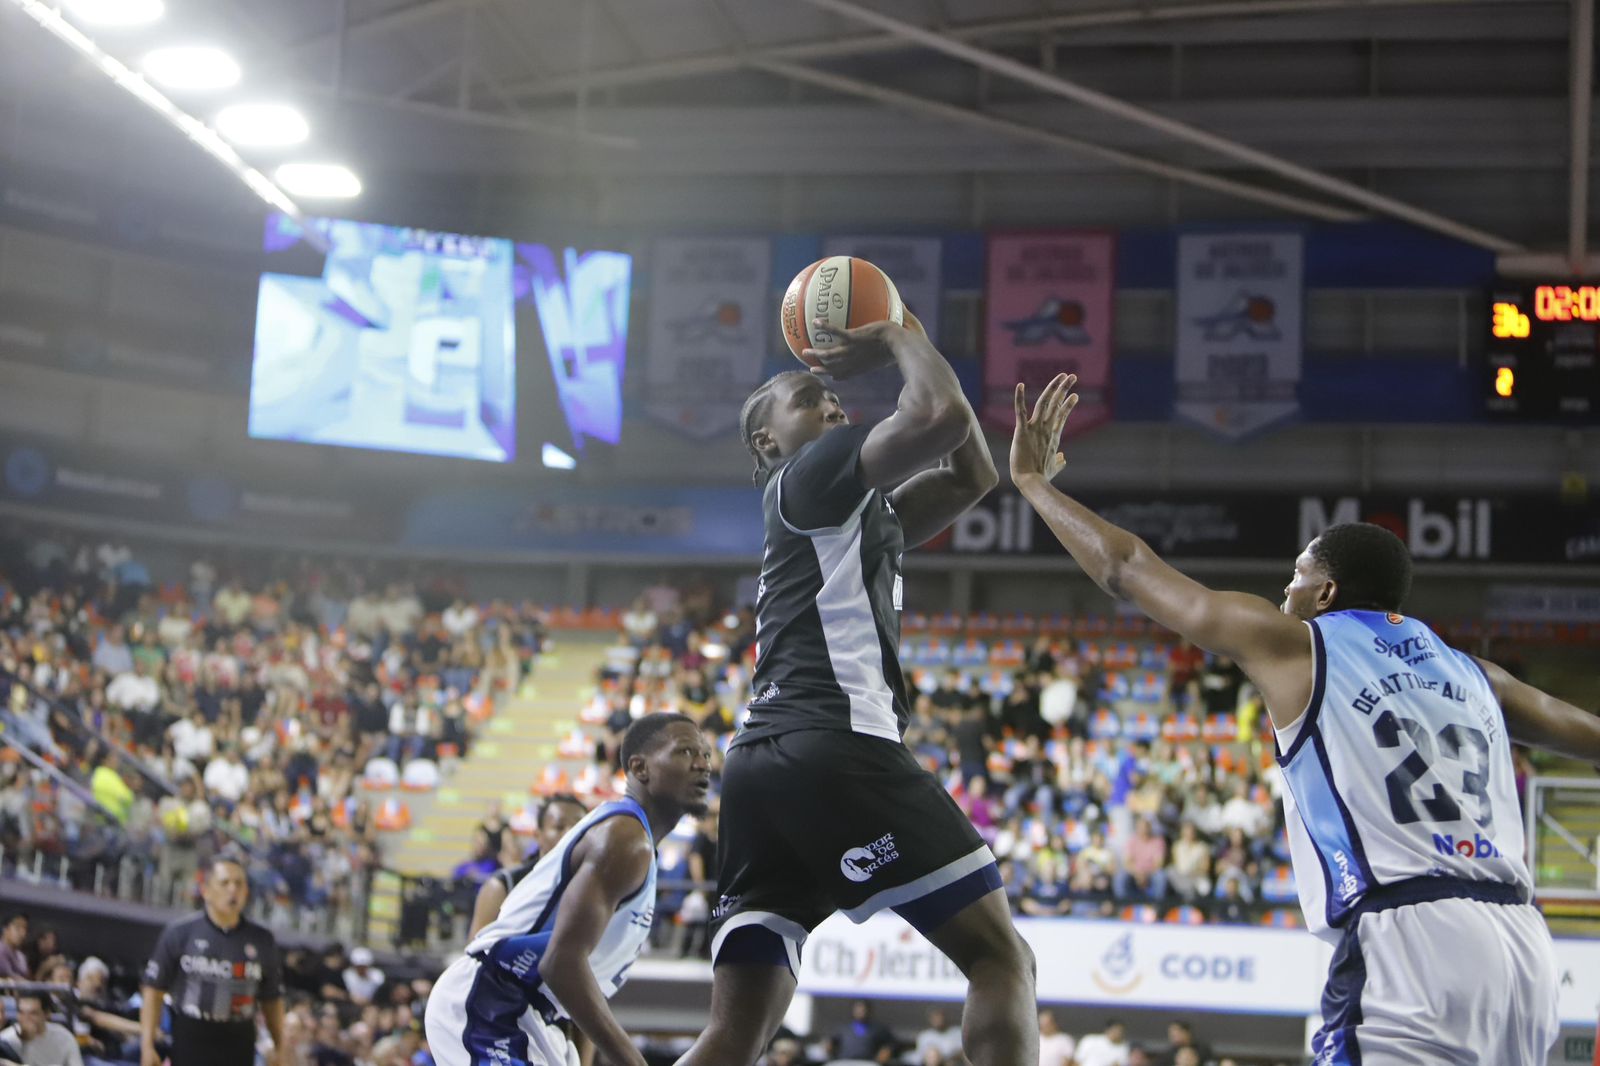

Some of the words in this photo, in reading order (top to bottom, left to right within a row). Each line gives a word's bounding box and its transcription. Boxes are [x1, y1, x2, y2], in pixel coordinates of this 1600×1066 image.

[815, 266, 839, 344] SPALDIG
[1372, 710, 1493, 829] 23
[1160, 953, 1256, 983] CODE
